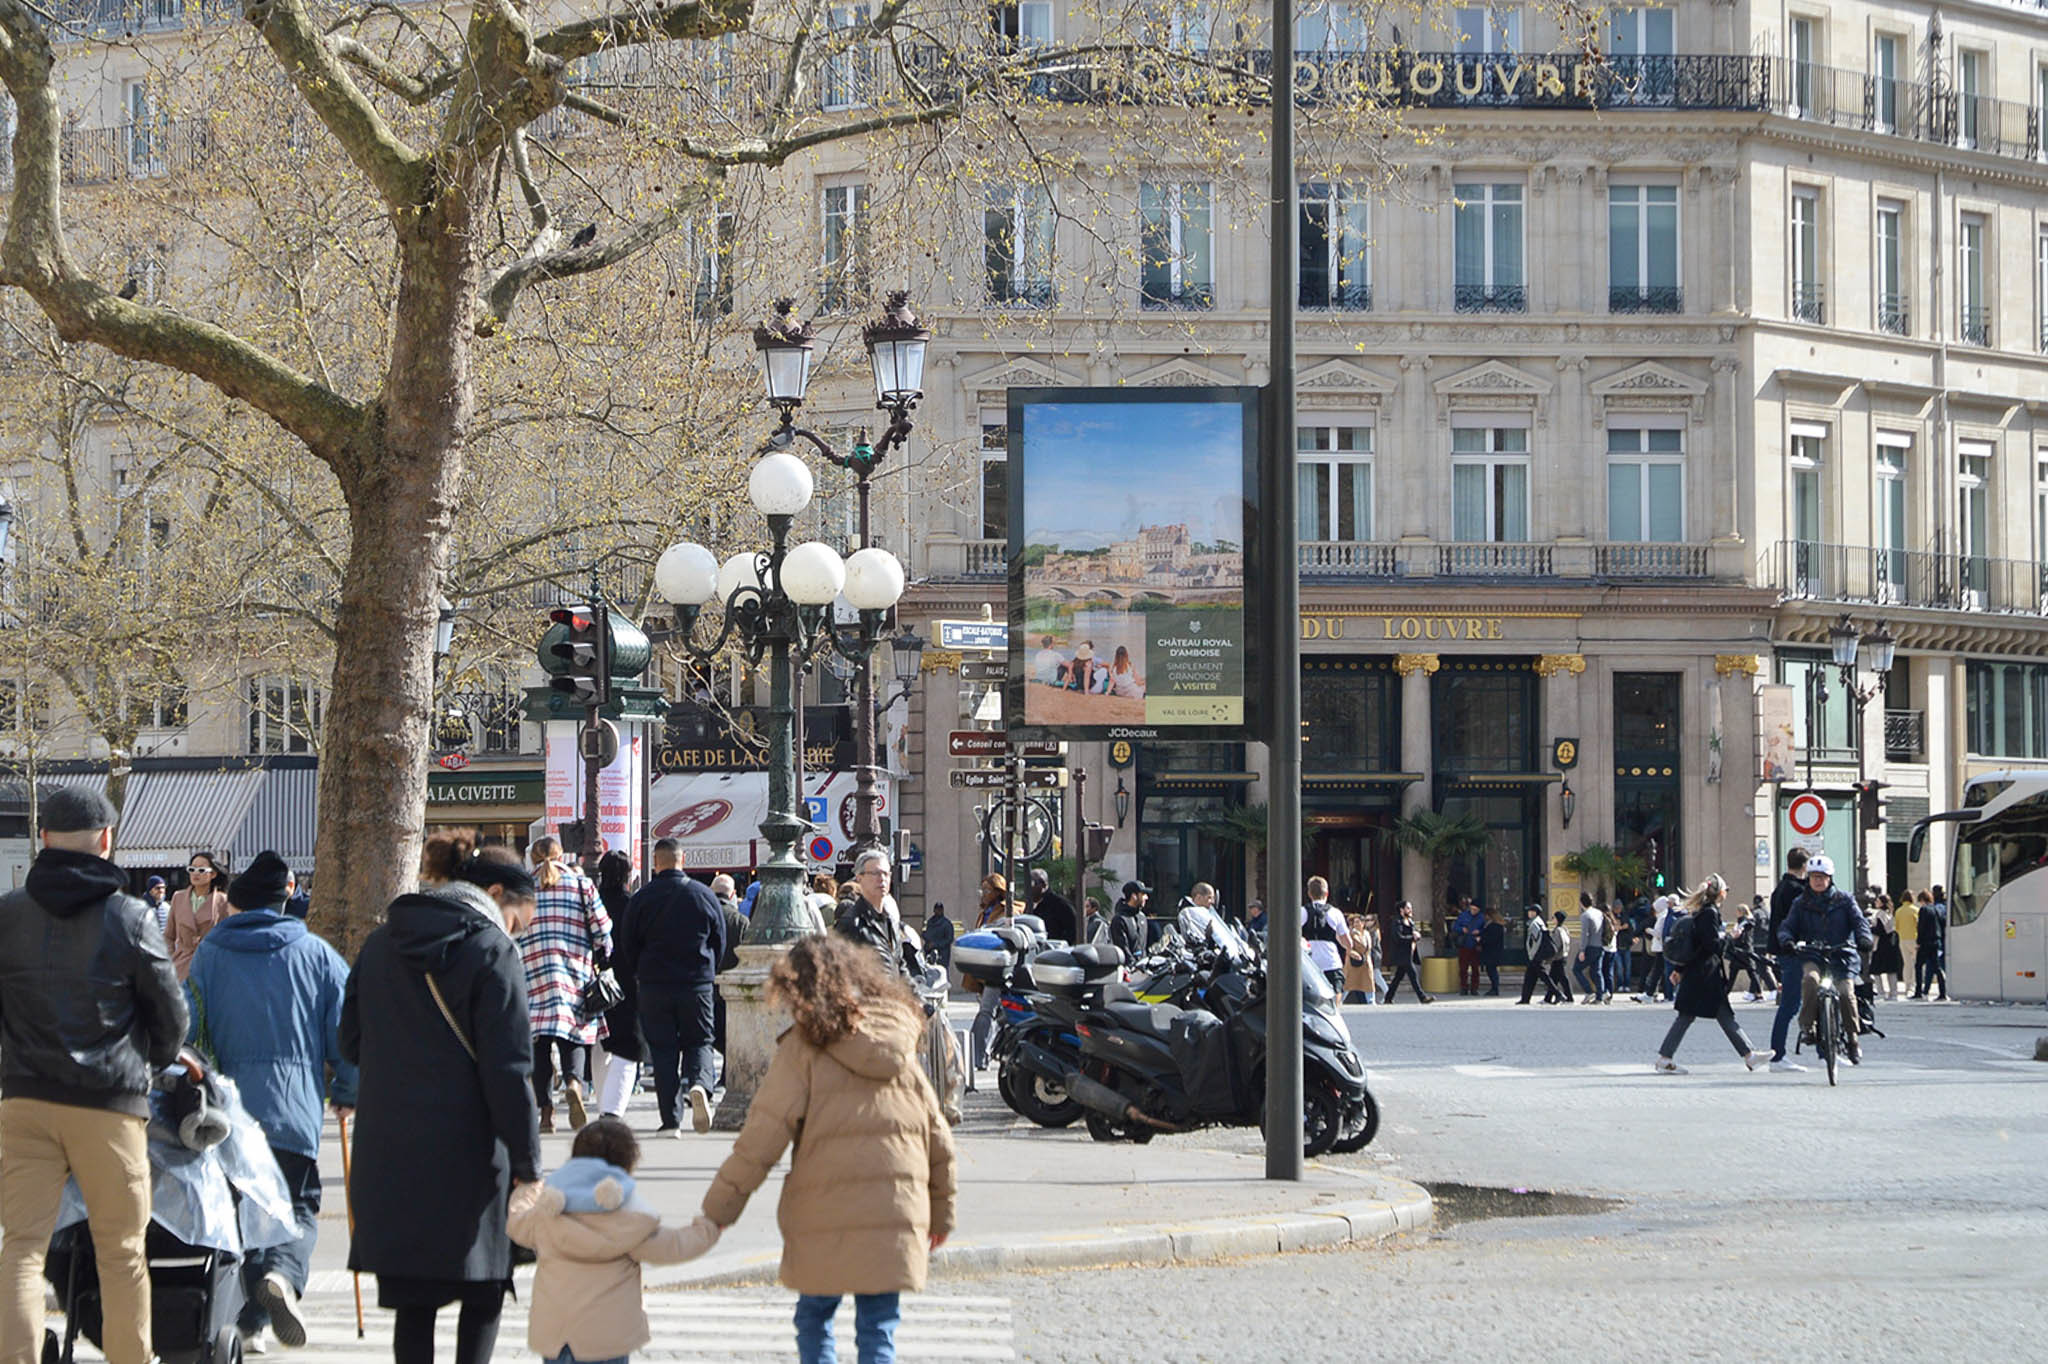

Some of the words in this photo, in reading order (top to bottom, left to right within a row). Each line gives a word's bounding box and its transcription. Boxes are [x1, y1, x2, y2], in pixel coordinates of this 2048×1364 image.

[1380, 62, 1596, 96] LOUVRE
[1301, 617, 1345, 640] DU
[1383, 616, 1504, 640] LOUVRE
[1157, 636, 1200, 647] CHÂTEAU
[1202, 638, 1233, 647] ROYAL
[1169, 648, 1221, 657] D'AMBOISE
[1166, 662, 1224, 671] SIMPLEMENT
[1168, 672, 1221, 681] GRANDIOSE
[1182, 682, 1217, 691] VISITER
[1107, 728, 1158, 738] JCDecaux
[967, 739, 993, 749] Conseil
[661, 749, 701, 767] CAFE
[704, 748, 727, 766] DE
[730, 748, 757, 766] LA
[426, 787, 436, 801] A
[438, 786, 456, 801] LA
[458, 784, 516, 801] CIVETTE
[684, 848, 733, 866] OMEDIE
